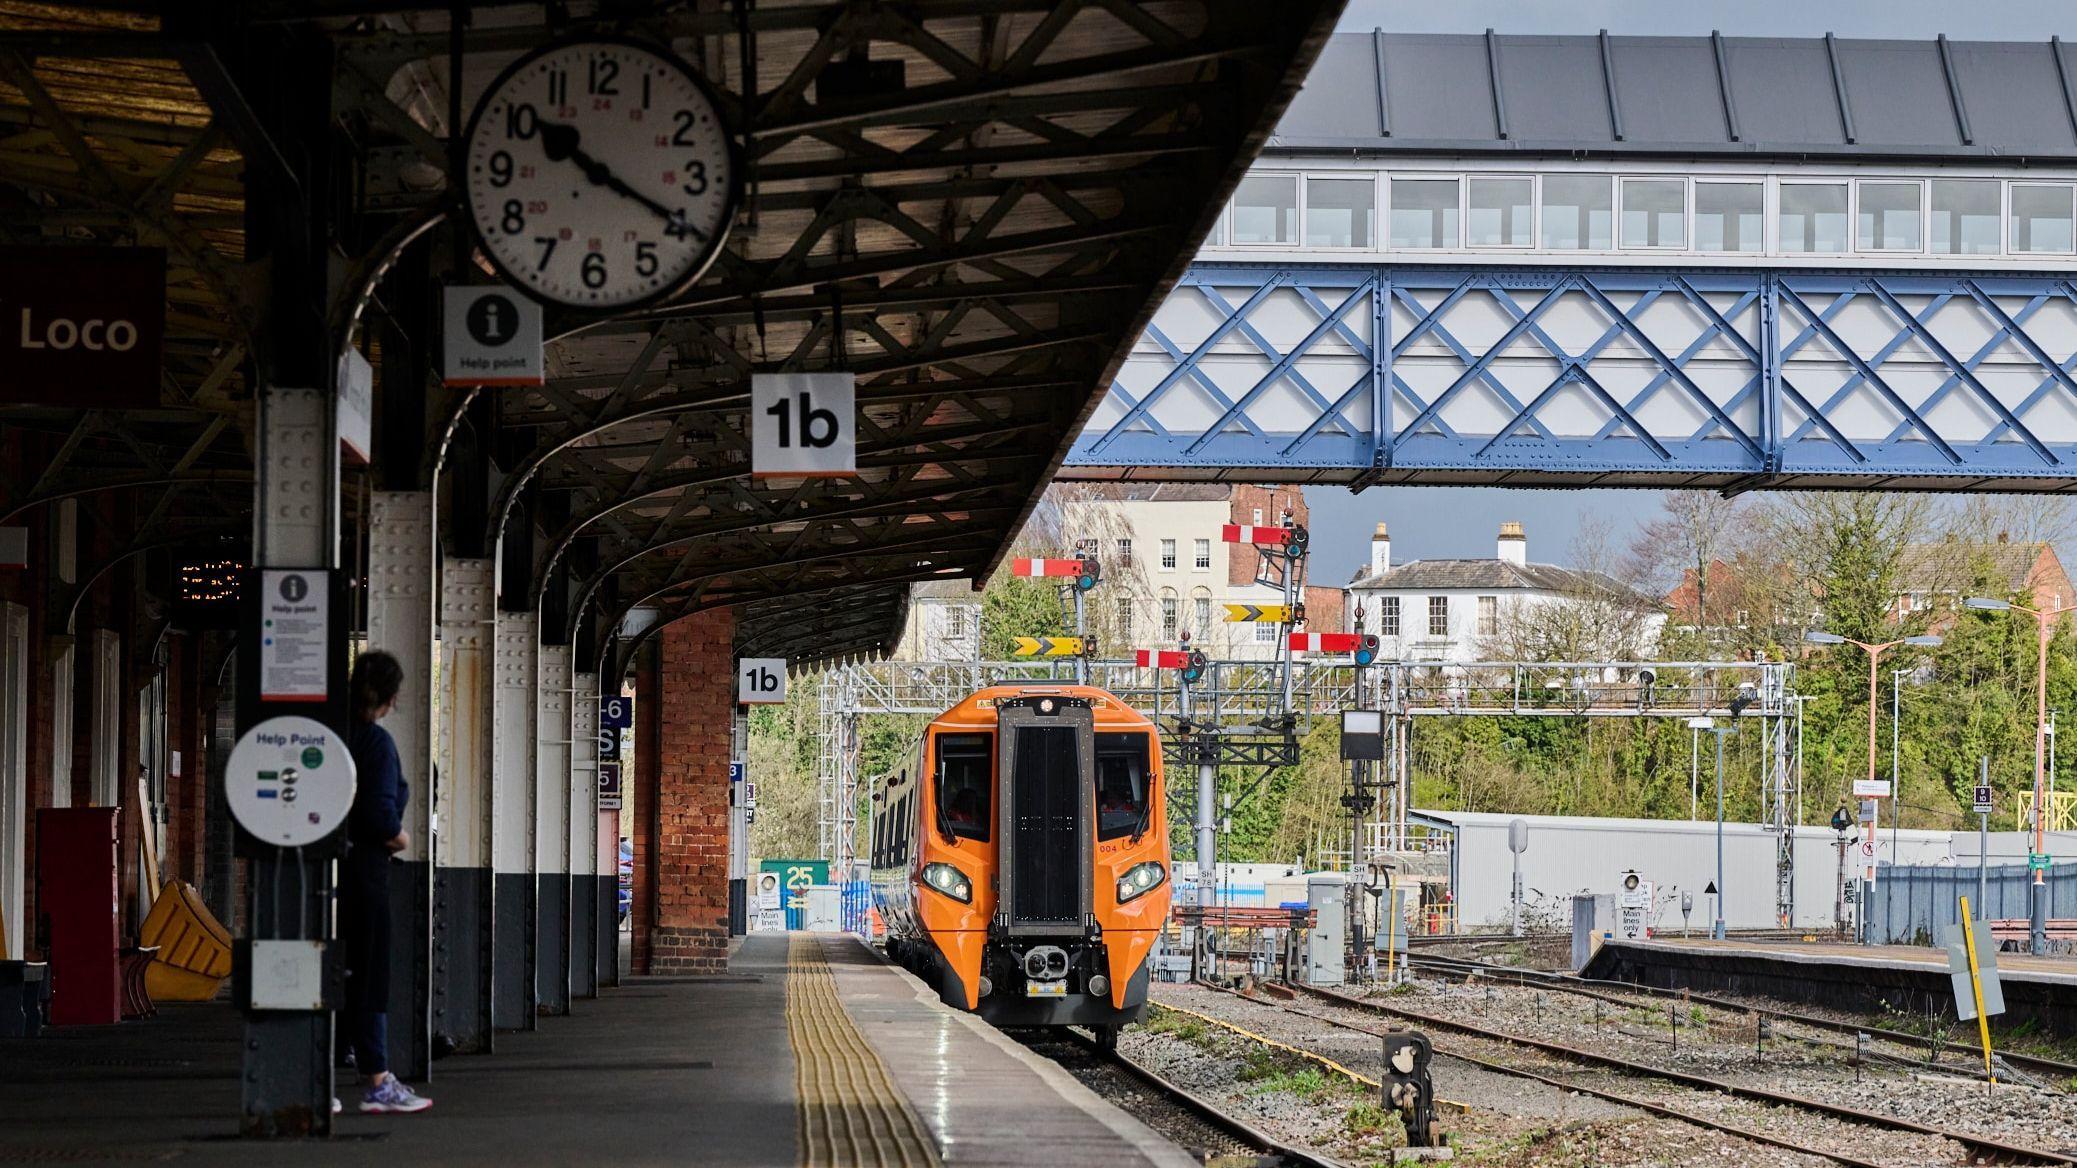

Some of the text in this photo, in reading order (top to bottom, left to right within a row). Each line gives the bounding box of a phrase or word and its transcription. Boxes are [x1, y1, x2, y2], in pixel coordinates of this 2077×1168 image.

[550, 70, 566, 107] 11
[589, 60, 619, 96] 12
[643, 73, 650, 110] 1
[507, 103, 538, 140] 10
[672, 110, 695, 147] 2
[488, 150, 514, 188] 9
[683, 160, 708, 196] 3
[502, 199, 525, 236] 8
[534, 237, 558, 272] 7
[581, 253, 608, 290] 6
[635, 242, 659, 278] 5
[20, 307, 139, 352] Loco
[460, 357, 527, 370] Help point
[766, 392, 839, 449] 1b
[272, 605, 292, 614] Help
[746, 666, 778, 693] 1b
[256, 733, 326, 747] Help Point
[787, 866, 814, 890] 25
